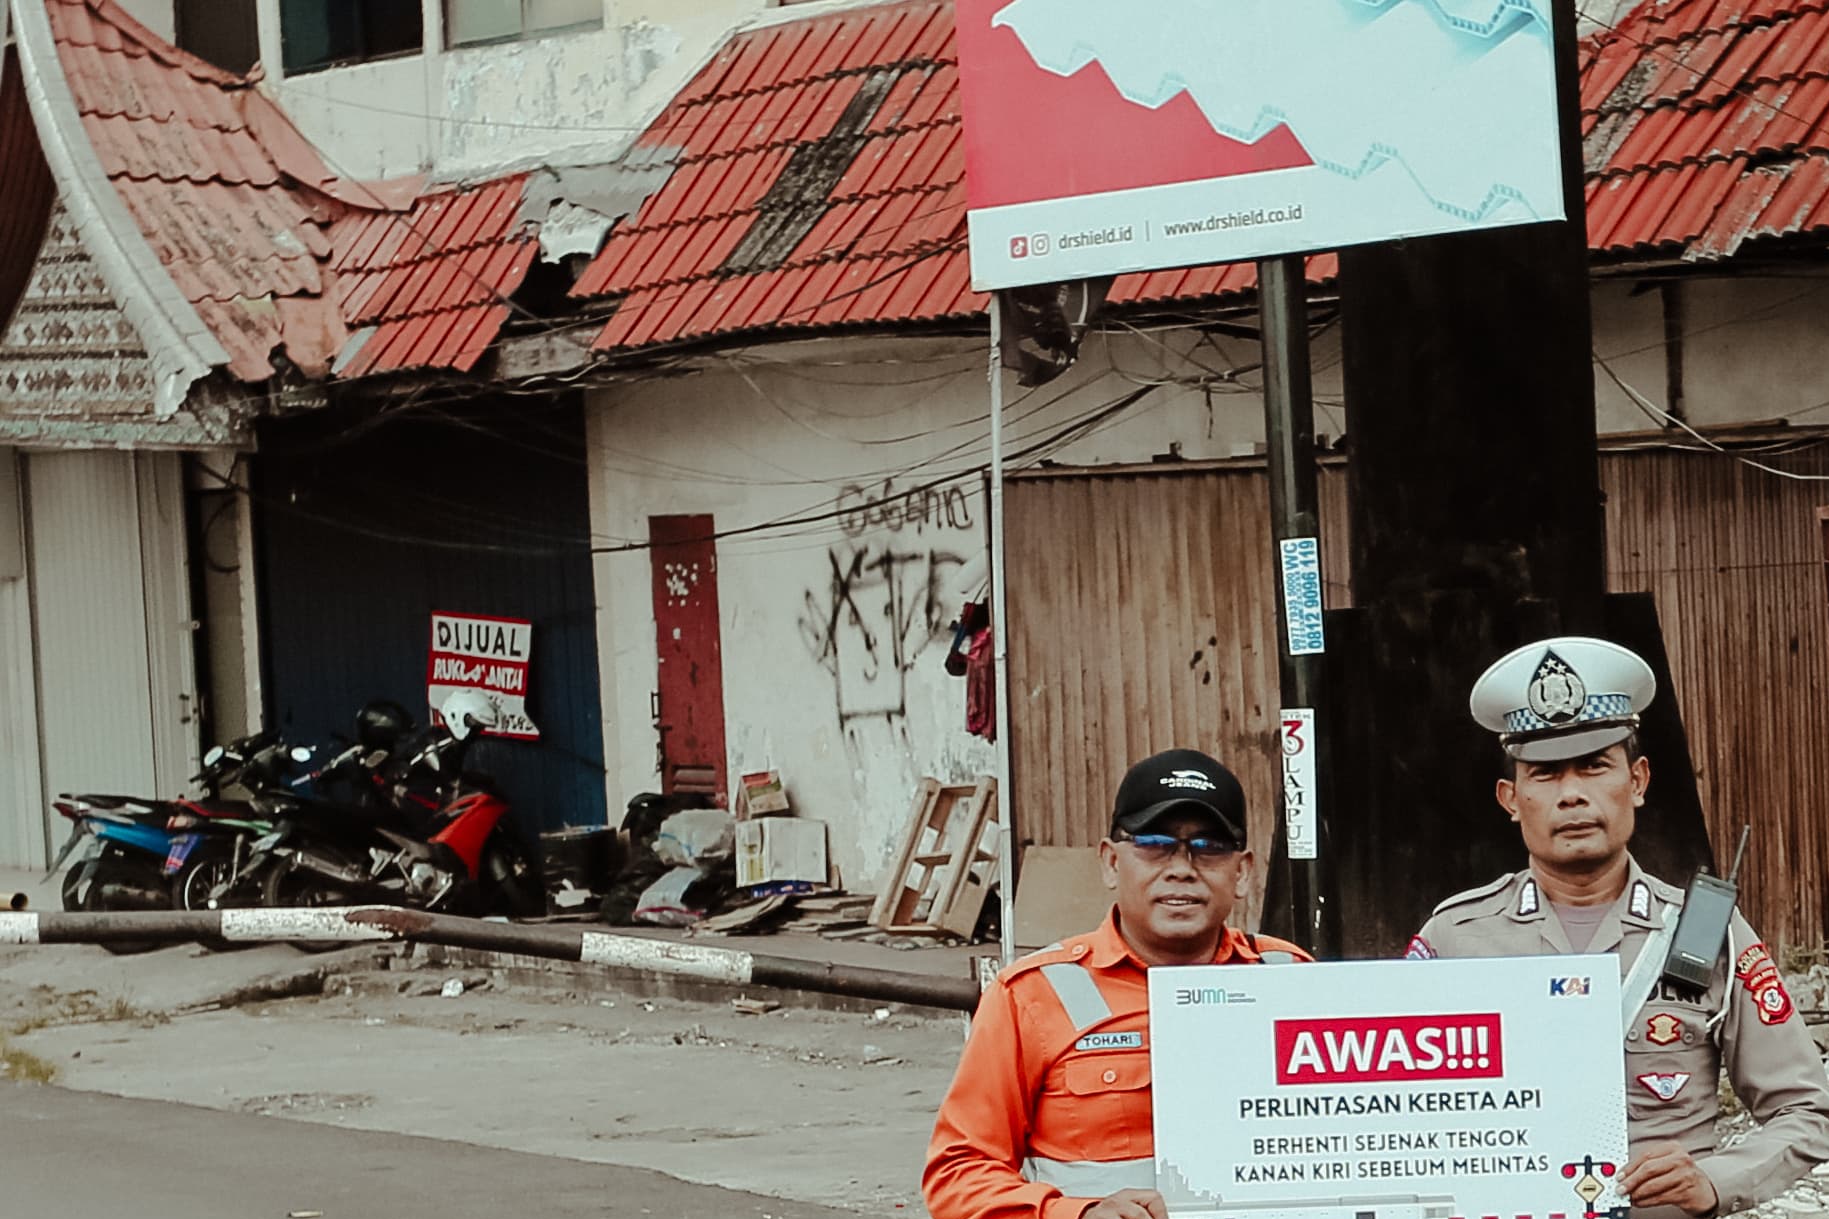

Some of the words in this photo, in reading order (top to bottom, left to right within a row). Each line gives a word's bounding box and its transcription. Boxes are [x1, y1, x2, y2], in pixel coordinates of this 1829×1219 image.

[1058, 226, 1133, 250] drshield.id
[1164, 205, 1303, 237] www.drshield.co.id
[1283, 542, 1299, 571] WC
[1298, 540, 1316, 567] 119
[1301, 572, 1320, 608] 9096
[436, 621, 522, 657] DIJUAL
[1305, 612, 1322, 649] 0812
[1083, 1035, 1133, 1047] TOHARI
[1286, 1026, 1490, 1074] AWAS!!!
[1239, 1093, 1401, 1118] PERLINTASAN
[1408, 1090, 1498, 1113] KERETA
[1502, 1089, 1541, 1110] API
[1253, 1135, 1348, 1155] BERHENTI
[1355, 1132, 1439, 1151] SEJENAK
[1446, 1129, 1529, 1148] TENGOK
[1234, 1163, 1305, 1182] KANAN
[1312, 1162, 1350, 1180] KIRI
[1358, 1159, 1445, 1179] SEBELUM
[1453, 1155, 1549, 1175] MELINTAS
